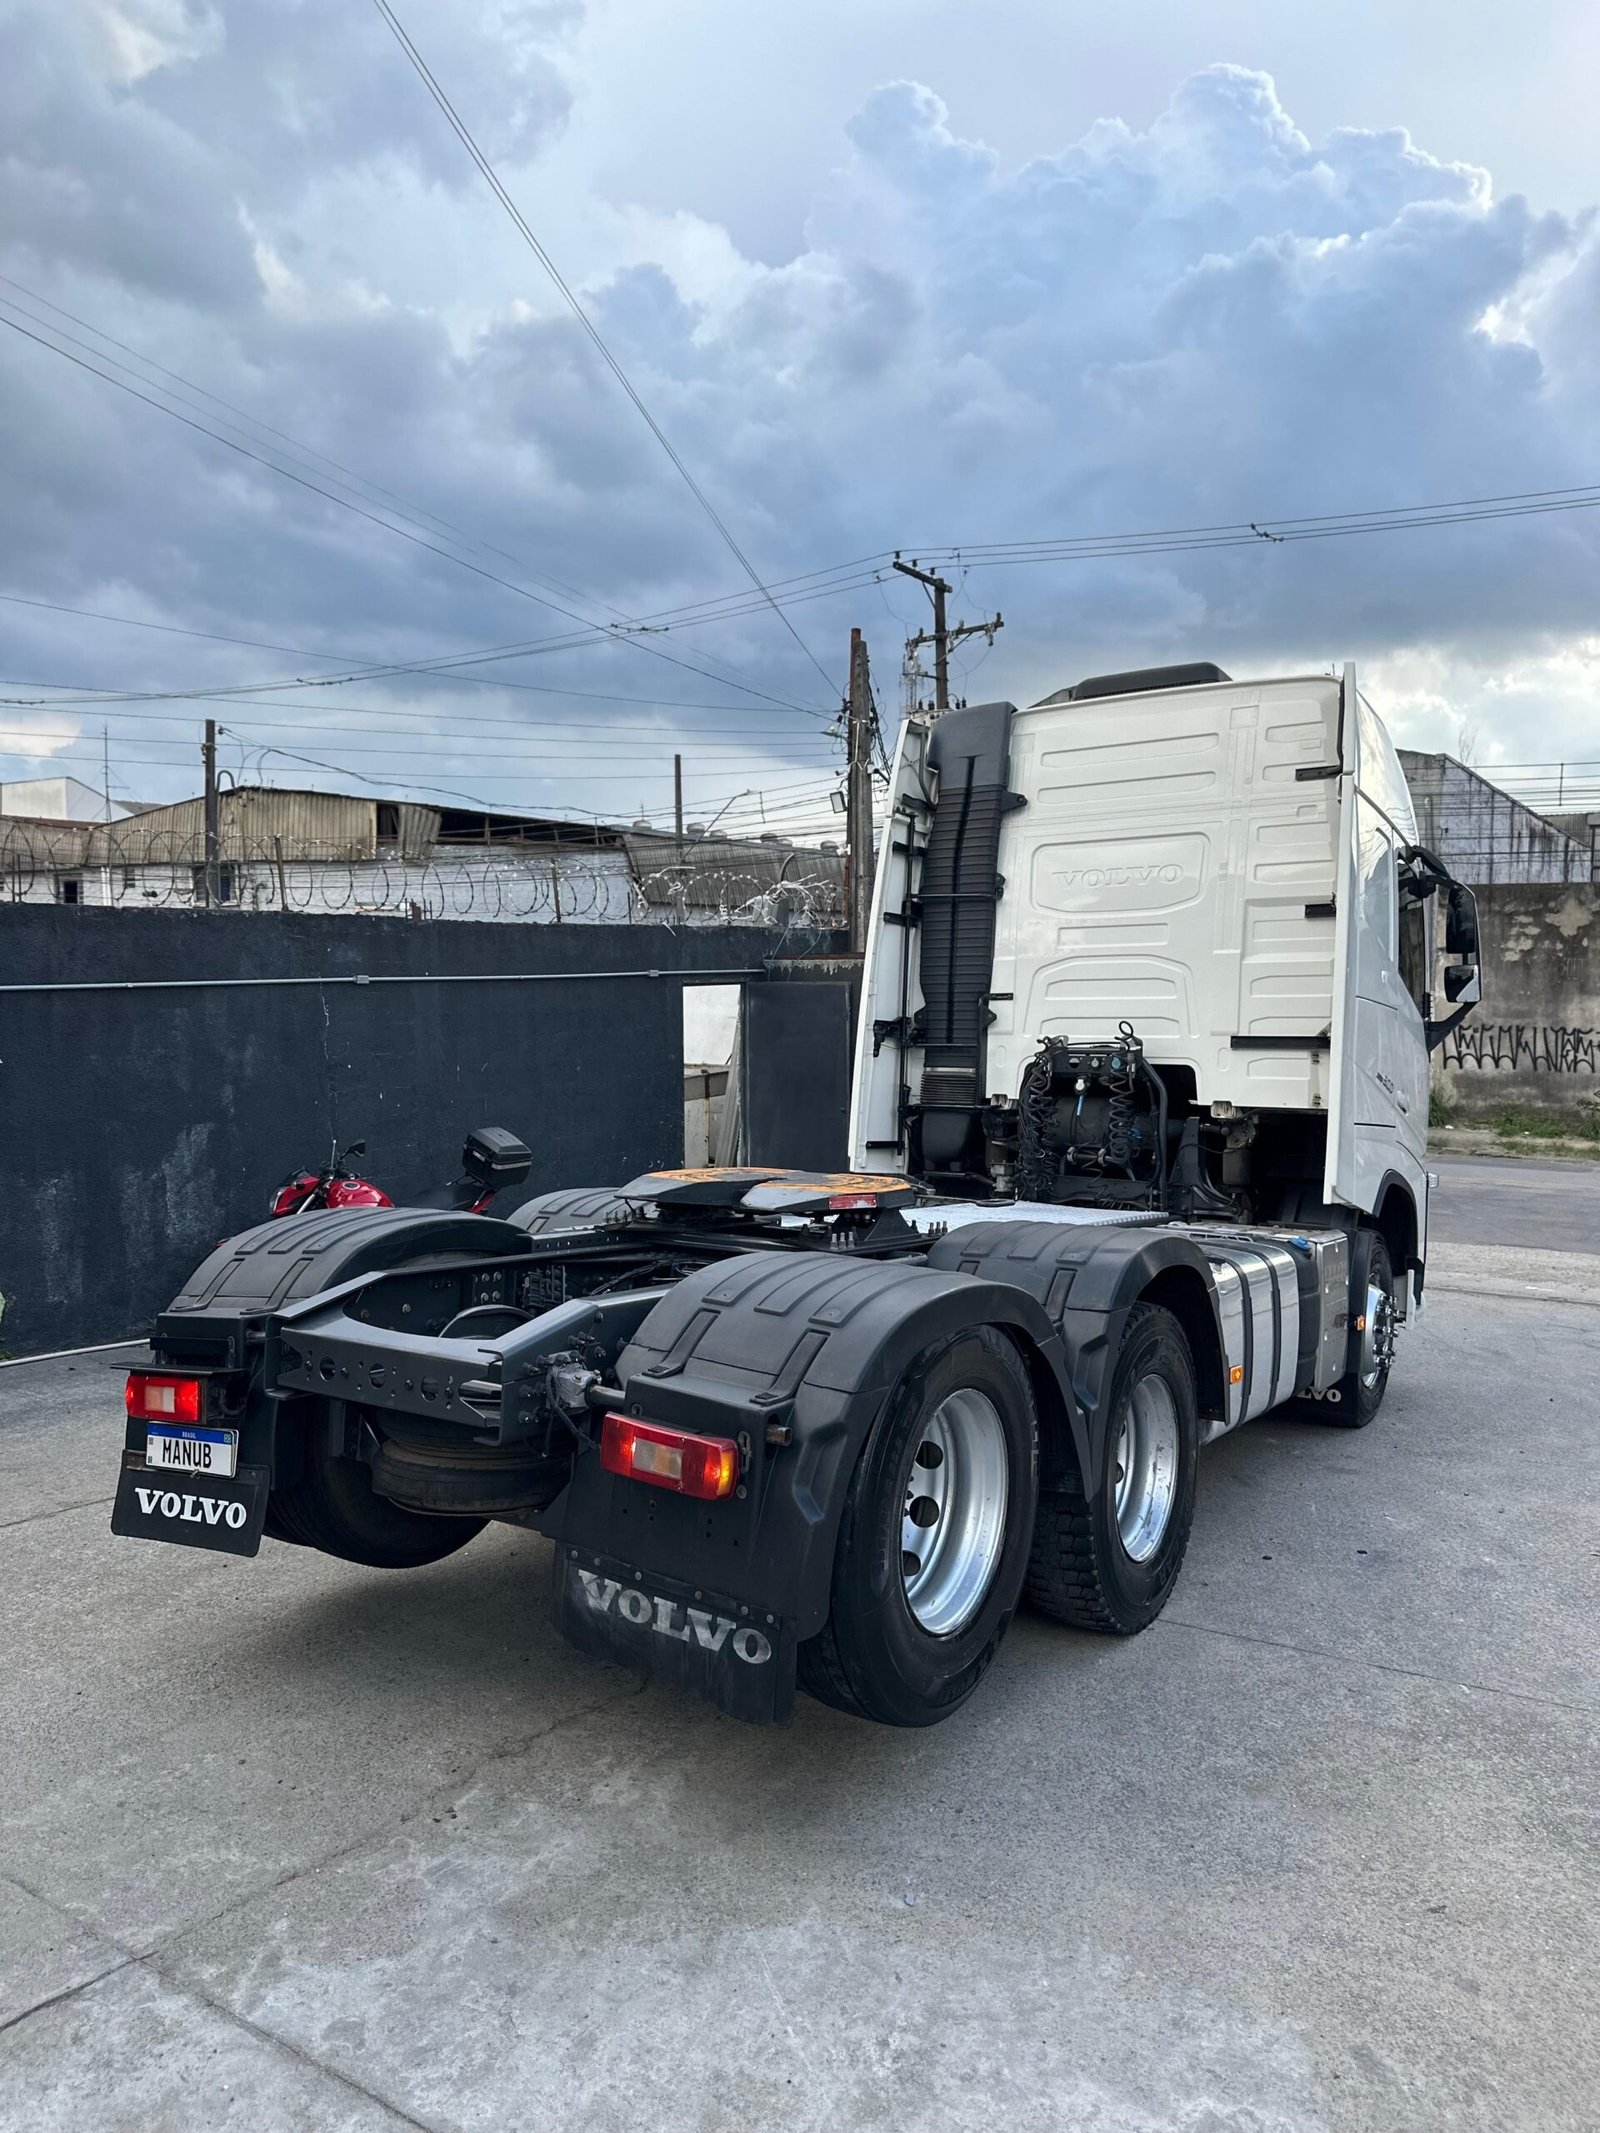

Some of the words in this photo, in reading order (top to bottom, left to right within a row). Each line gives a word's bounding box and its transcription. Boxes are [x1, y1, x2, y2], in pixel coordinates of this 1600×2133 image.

[1052, 864, 1184, 888] VOLVO
[1296, 1386, 1342, 1402] LVO
[182, 1431, 196, 1439] BRASIL
[162, 1438, 212, 1469] MANUB
[134, 1487, 247, 1529] VOLVO
[578, 1568, 772, 1664] VOLVO
